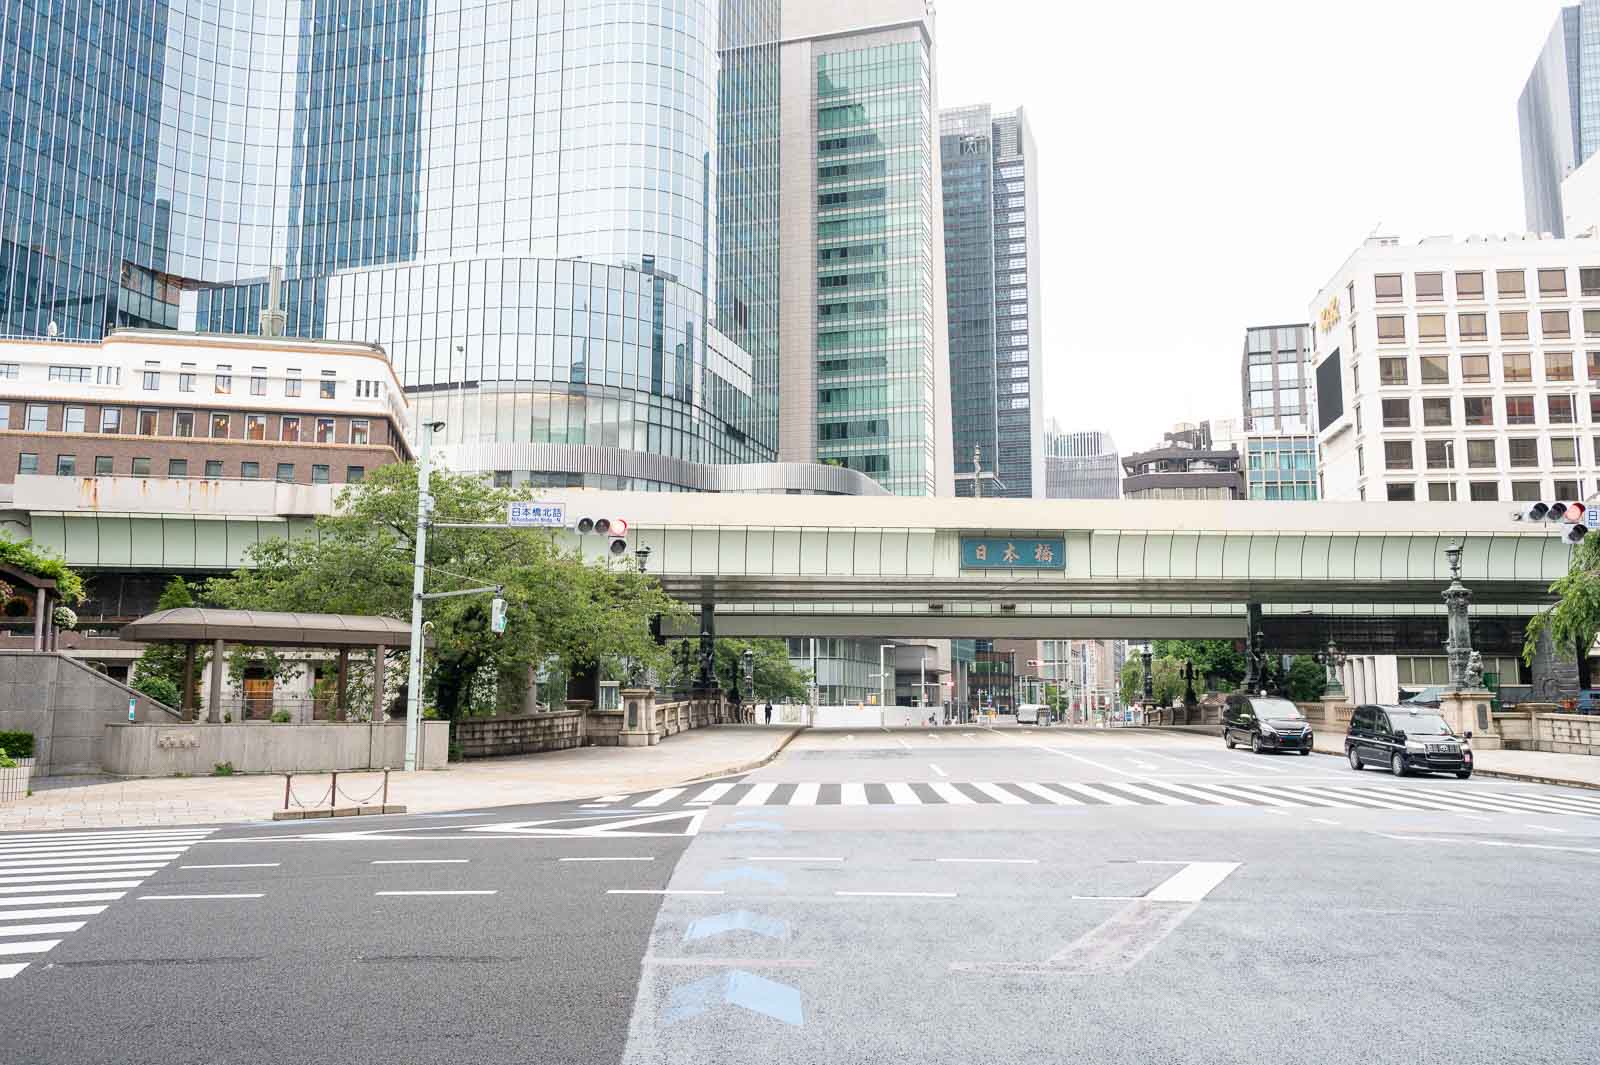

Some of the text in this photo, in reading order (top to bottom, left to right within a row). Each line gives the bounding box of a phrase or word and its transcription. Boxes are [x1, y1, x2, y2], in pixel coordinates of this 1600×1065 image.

[511, 507, 561, 517] 日本橋北詰
[975, 542, 1054, 562] 日本橋
